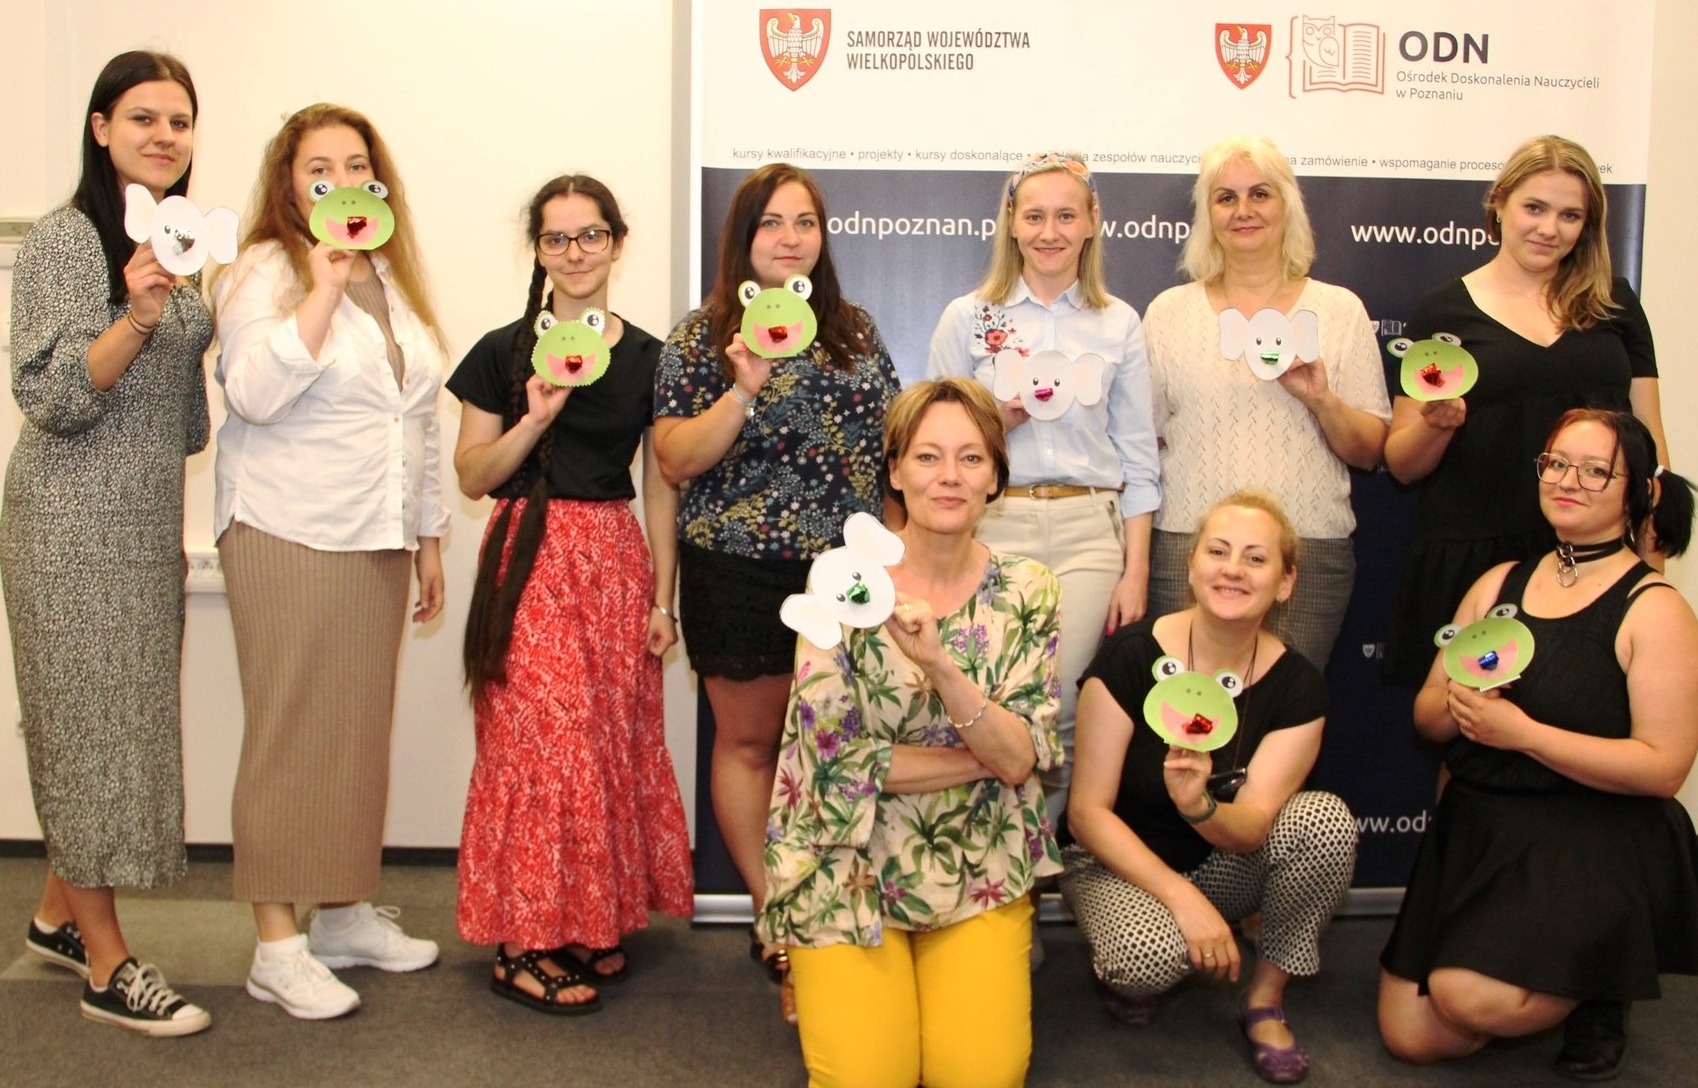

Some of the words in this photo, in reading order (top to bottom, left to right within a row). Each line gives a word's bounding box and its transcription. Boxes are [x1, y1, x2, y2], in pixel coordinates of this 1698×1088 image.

[846, 30, 922, 51] SAMORZĄD
[927, 27, 1031, 49] WOJEWÓDZTWA
[1398, 30, 1489, 64] ODN
[846, 52, 974, 70] WIELKOPOLSKIEGO
[1396, 70, 1448, 83] Ośrodek
[1450, 72, 1531, 87] Doskonalenia
[1533, 75, 1600, 90] Nauczycieli
[1396, 89, 1406, 98] w
[1410, 88, 1463, 100] Poznaniu
[732, 148, 763, 161] kursy
[767, 148, 847, 162] kwalifikacyjne
[857, 149, 904, 162] projekty
[915, 149, 947, 162] kursy
[950, 150, 1023, 163] doskonalące
[1092, 151, 1147, 164] zespołów
[1300, 155, 1368, 167] zamówienie
[1379, 158, 1457, 171] wspomaganie
[1355, 809, 1432, 833] ww.od
